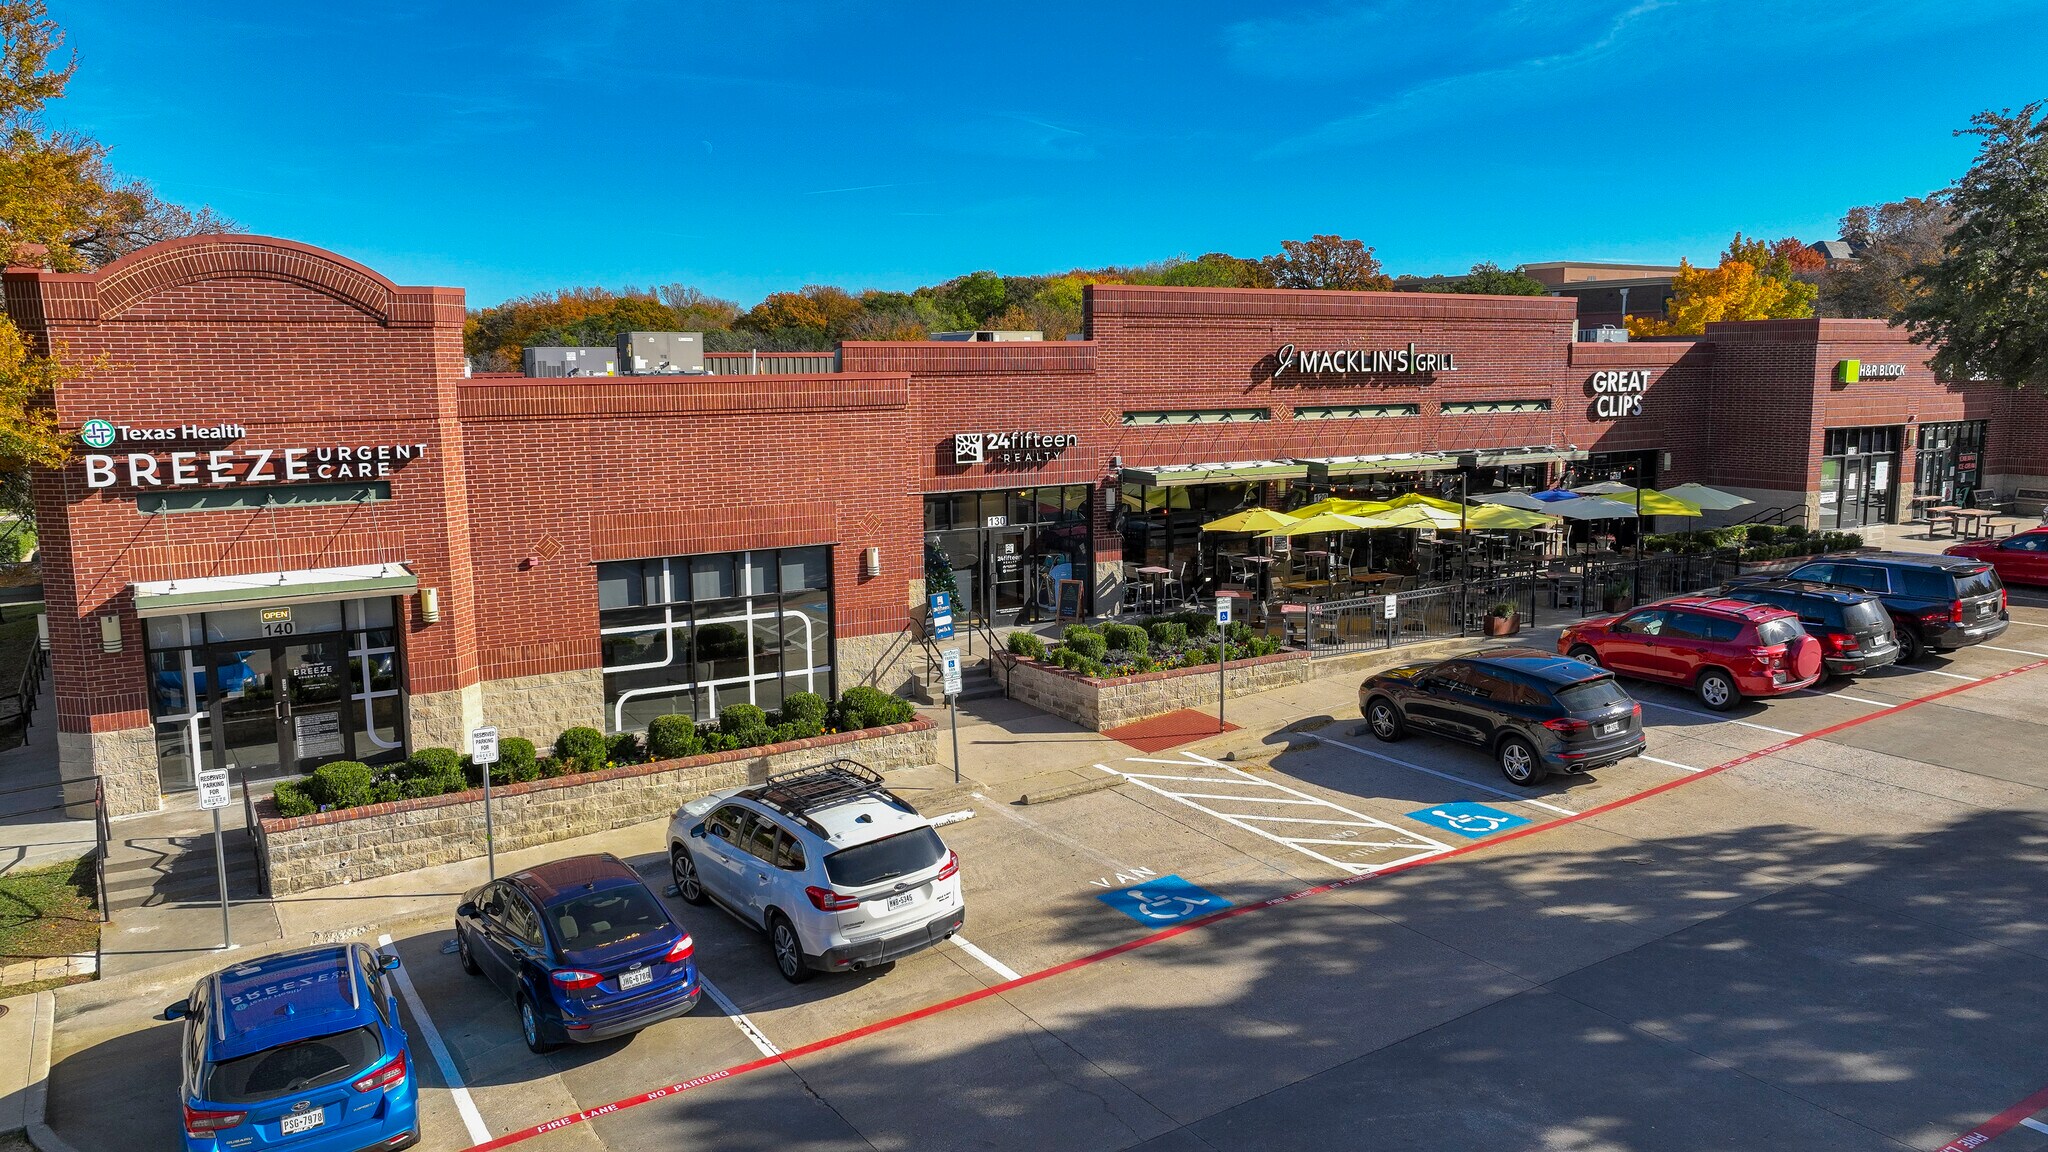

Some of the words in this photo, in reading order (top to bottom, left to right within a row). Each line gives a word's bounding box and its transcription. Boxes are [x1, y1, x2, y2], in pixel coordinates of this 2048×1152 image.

[1300, 348, 1408, 374] MACKLIN'S
[1415, 353, 1458, 373] GRILL
[1859, 364, 1877, 377] H&R
[1878, 364, 1906, 377] BLOCK
[1592, 370, 1651, 393] GREAT
[1596, 395, 1643, 418] CLIPS
[118, 425, 175, 441] Texas
[182, 423, 246, 440] Health
[986, 431, 1077, 450] 24fifteen
[316, 443, 428, 462] URGENT
[1003, 452, 1060, 463] REALTY
[85, 448, 311, 488] BREEZE
[317, 462, 391, 479] CARE
[989, 516, 1006, 526] 130
[263, 610, 288, 620] OPEN
[264, 622, 293, 637] 140
[293, 665, 333, 677] BREEZE
[473, 731, 496, 739] RESERVED
[475, 737, 494, 745] PARKING
[200, 773, 226, 782] RESERVED
[202, 780, 225, 789] PARKING
[209, 788, 220, 796] FOR
[1089, 866, 1157, 888] VAN
[536, 1117, 572, 1134] FIRE
[580, 1103, 619, 1121] LANE
[647, 1089, 666, 1101] NO
[673, 1070, 730, 1093] PARKING
